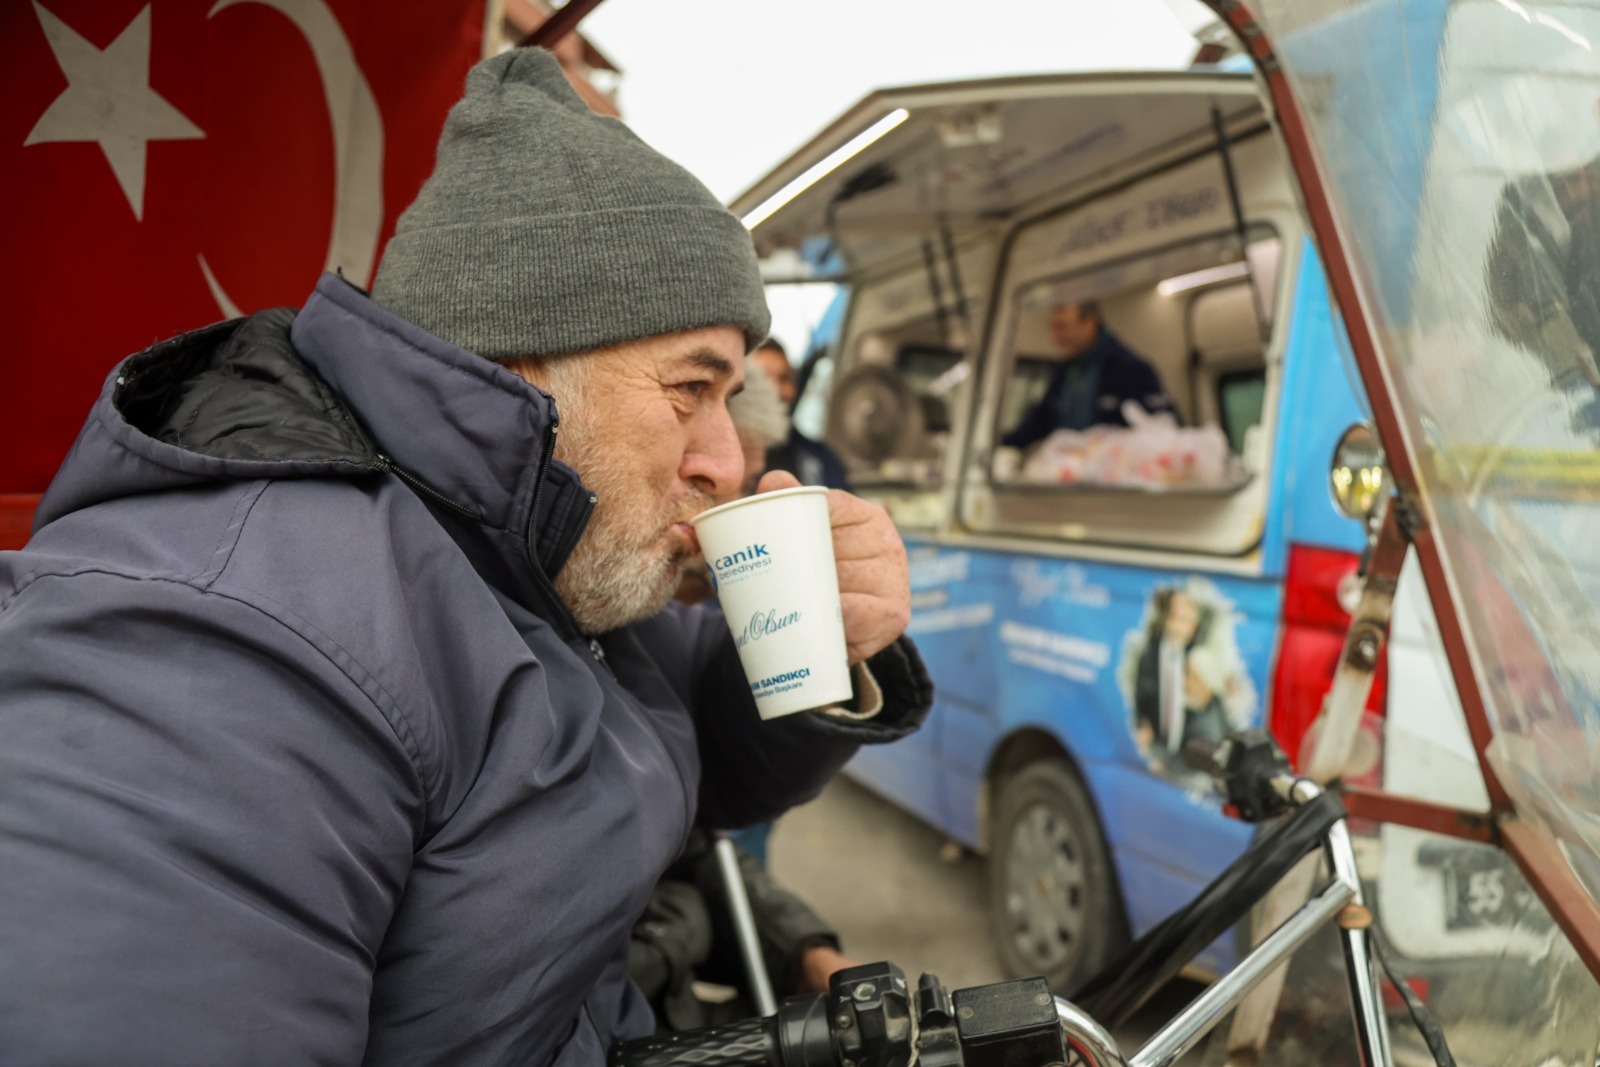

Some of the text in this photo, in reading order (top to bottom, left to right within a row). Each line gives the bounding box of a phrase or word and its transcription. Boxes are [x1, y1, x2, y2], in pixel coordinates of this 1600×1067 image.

[715, 544, 769, 570] canik
[719, 557, 772, 580] belediyesi
[750, 608, 800, 640] Olsun
[761, 667, 810, 688] SANDIKÇI
